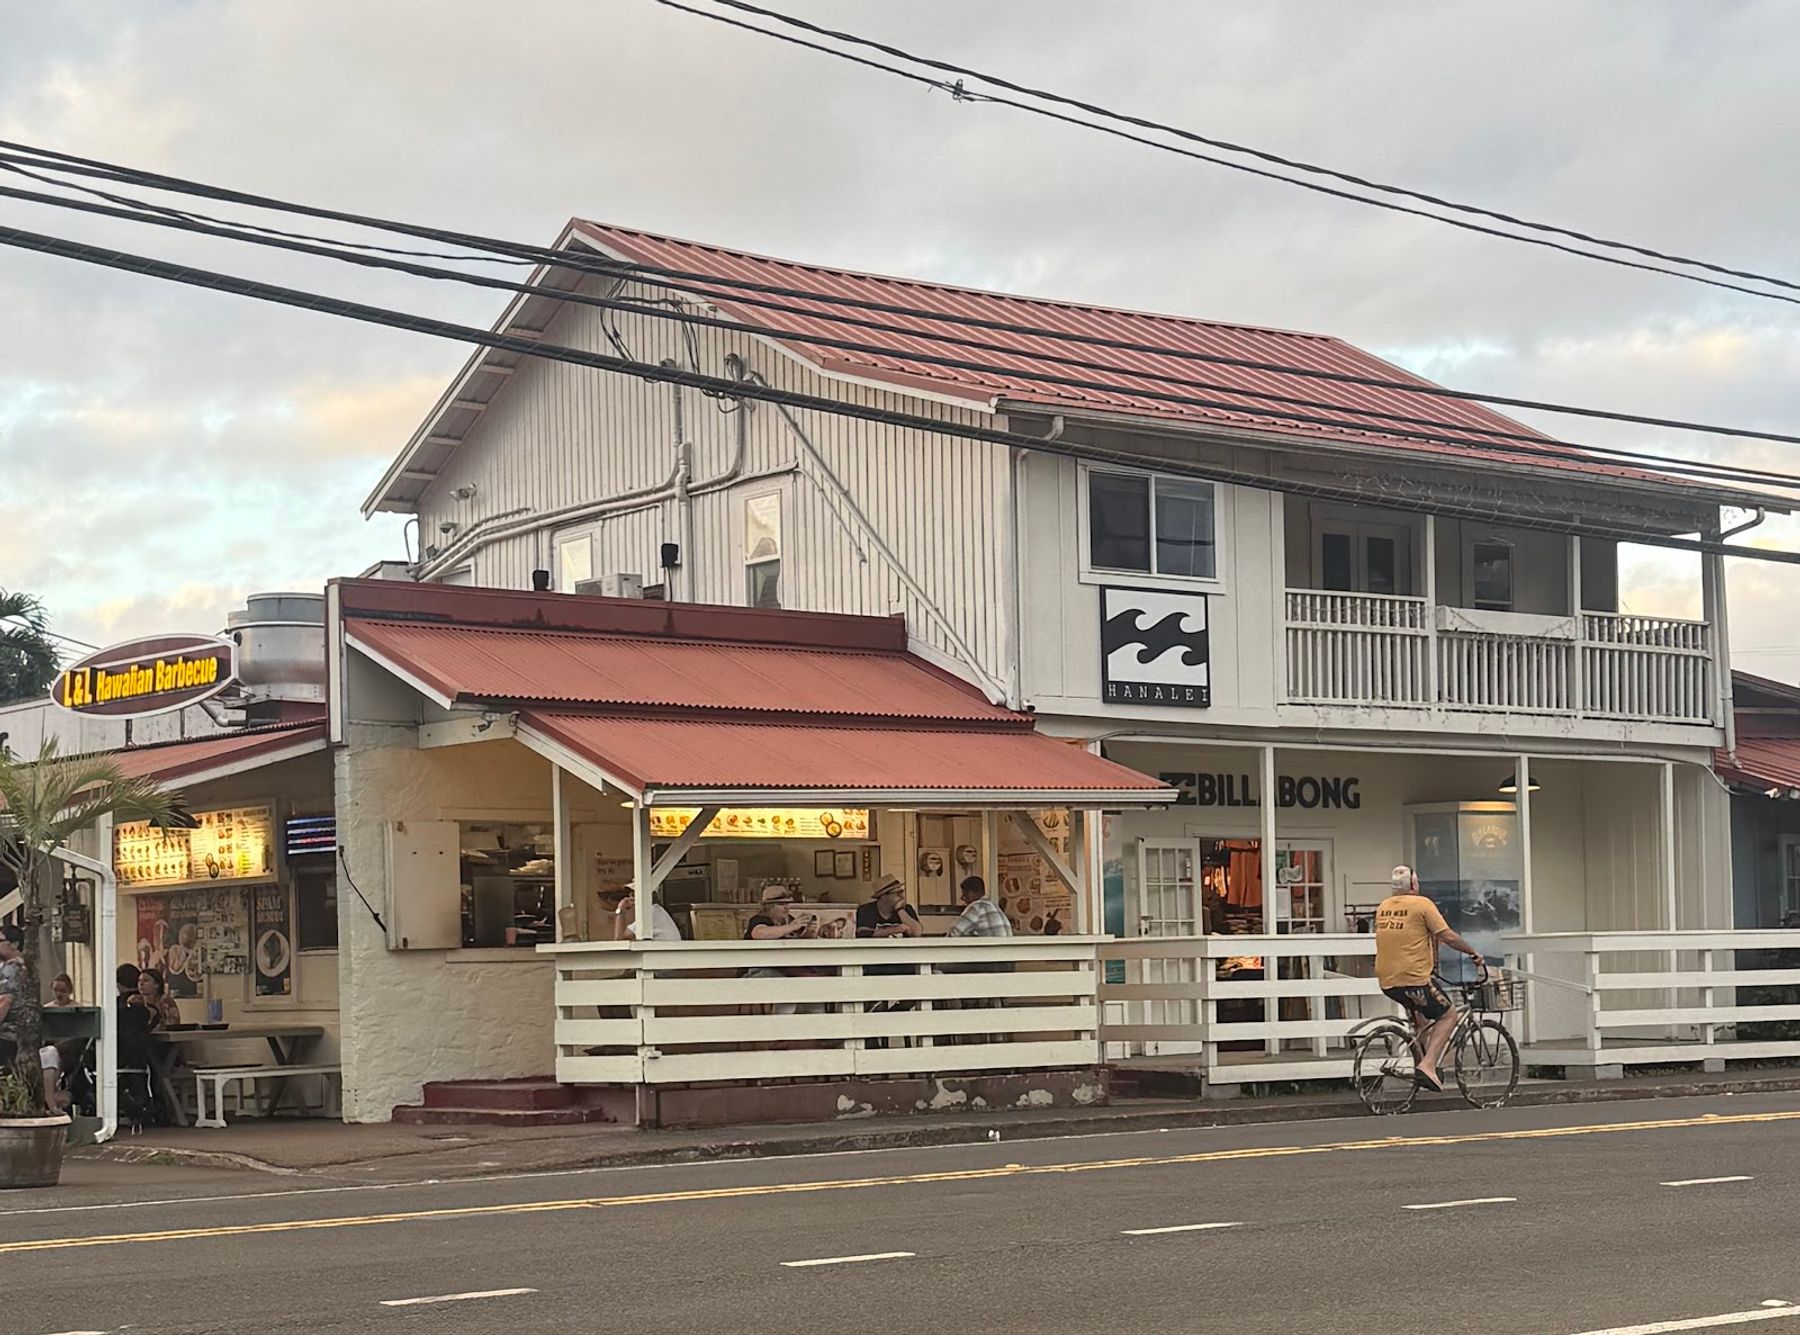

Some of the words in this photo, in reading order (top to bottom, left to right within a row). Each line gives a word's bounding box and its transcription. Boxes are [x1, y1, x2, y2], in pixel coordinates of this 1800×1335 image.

[96, 663, 154, 702] Hawaiian
[155, 655, 218, 691] Barbecue
[1108, 683, 1208, 702] HANALEI
[1198, 773, 1361, 809] BILLBONG
